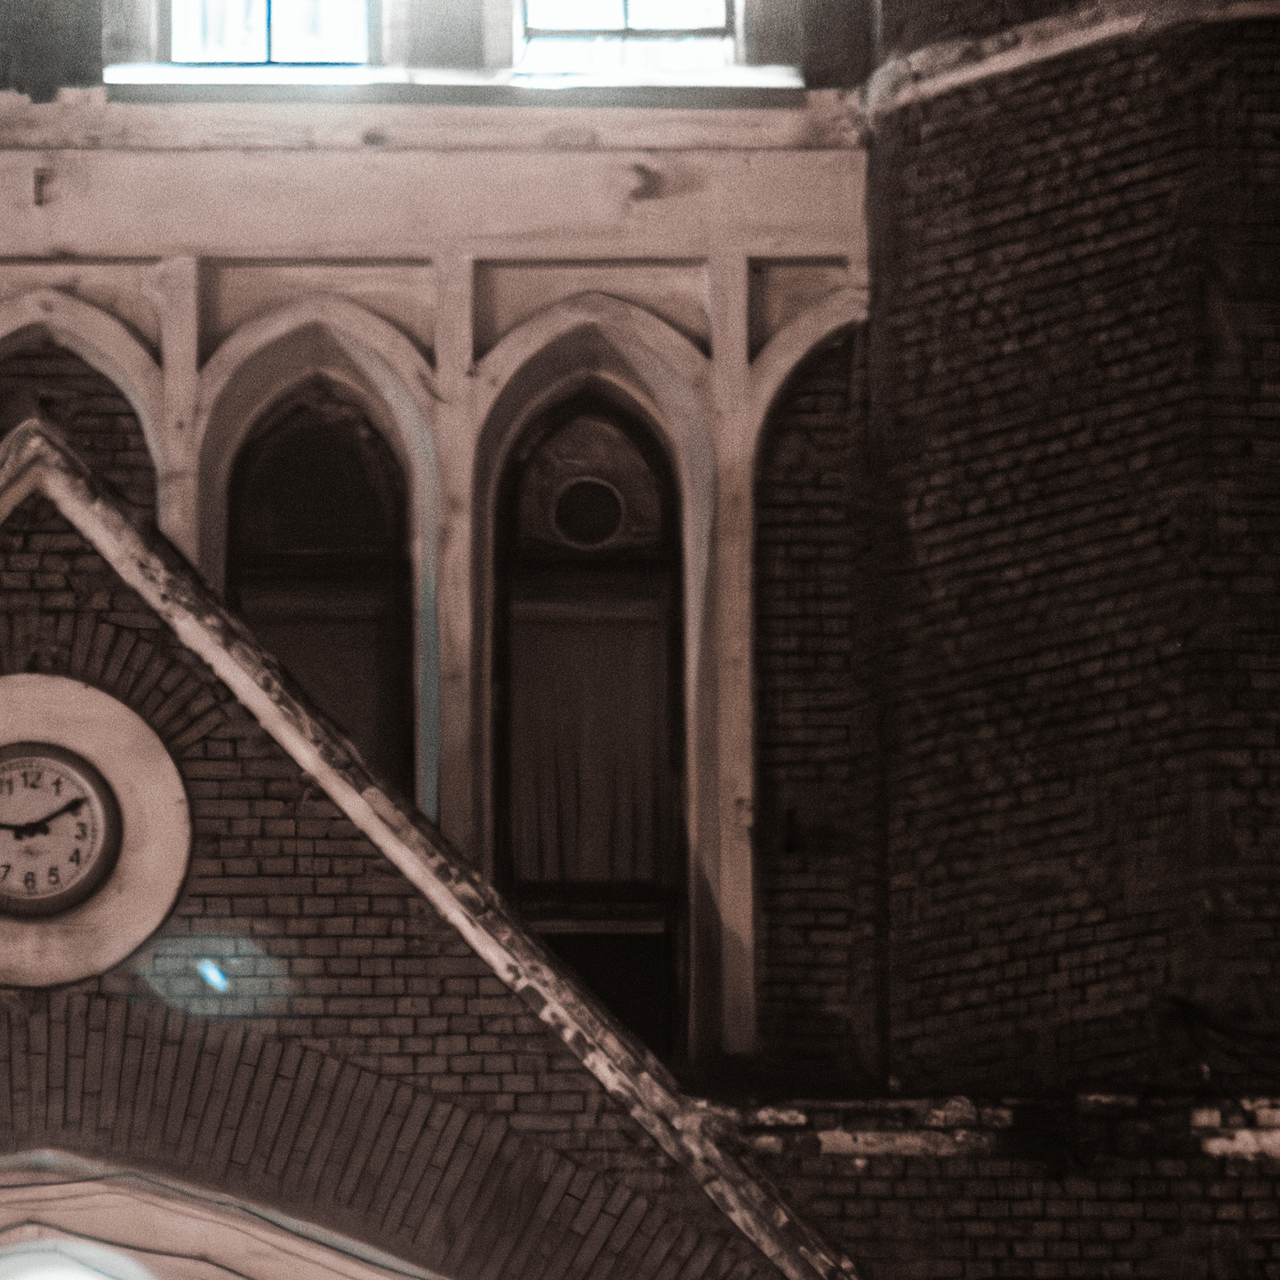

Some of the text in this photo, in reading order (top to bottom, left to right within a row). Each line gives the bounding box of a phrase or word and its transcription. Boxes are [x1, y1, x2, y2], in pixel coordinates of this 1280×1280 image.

[21, 771, 43, 789] 12
[52, 777, 63, 796] 1
[74, 822, 88, 841] 3
[69, 848, 81, 867] 4
[0, 864, 11, 881] 7
[24, 872, 36, 889] 6
[48, 866, 60, 885] 5
